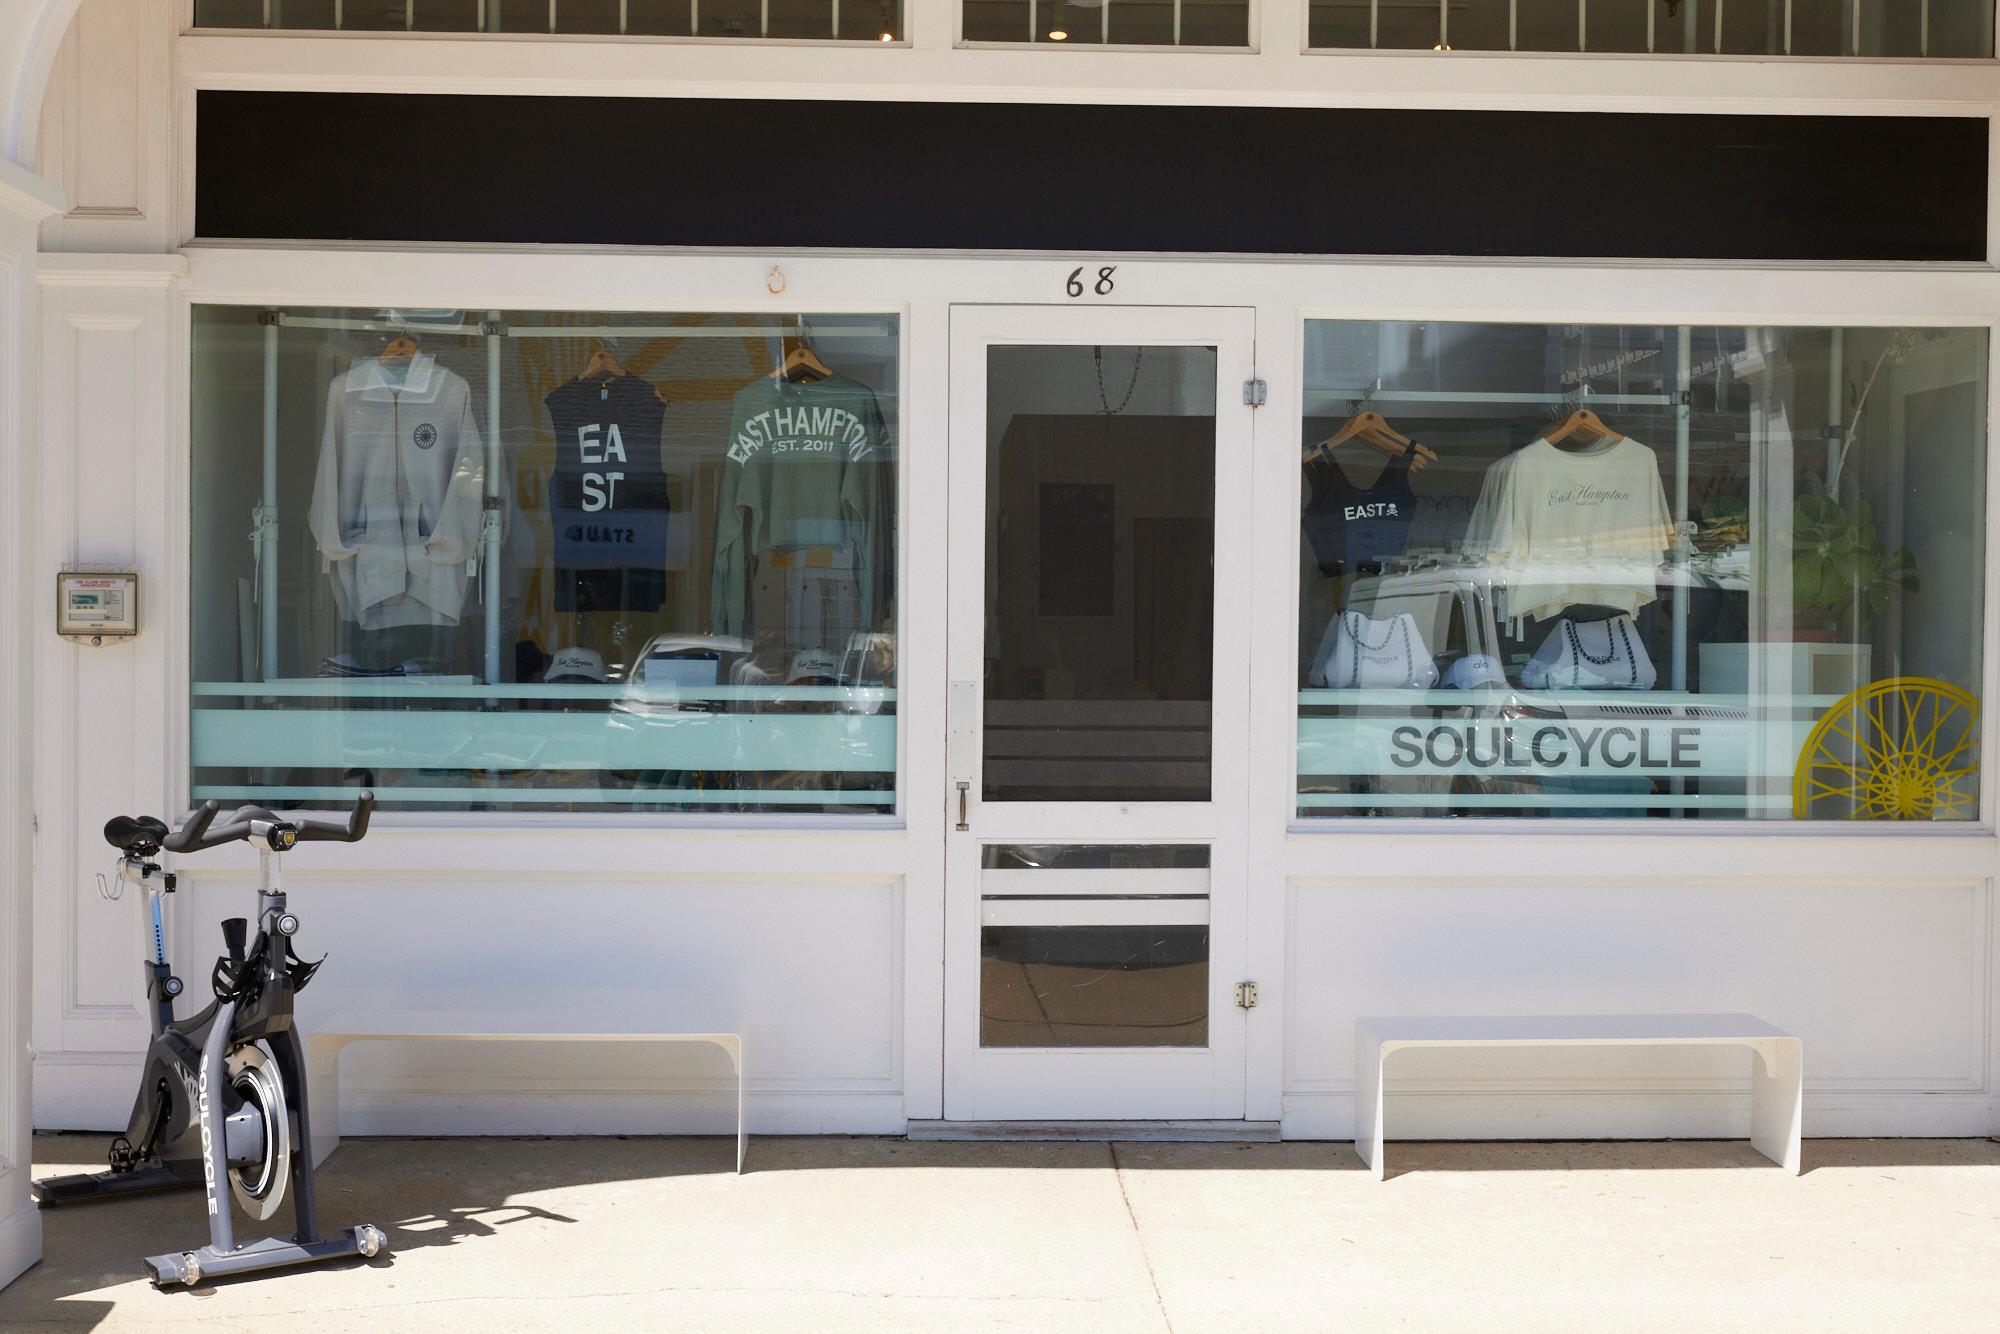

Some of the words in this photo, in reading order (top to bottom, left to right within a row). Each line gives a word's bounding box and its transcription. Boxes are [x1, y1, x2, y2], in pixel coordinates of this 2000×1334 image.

[1066, 265, 1117, 298] 68
[726, 411, 773, 468] EAST
[774, 406, 873, 463] HAMPTON
[802, 439, 834, 453] 2011
[1548, 488, 1572, 506] East
[1572, 483, 1632, 504] Hampton
[1344, 502, 1387, 521] EAST
[1390, 725, 1701, 769] SOULCYCLE
[199, 1054, 218, 1216] SOULCYCLE
